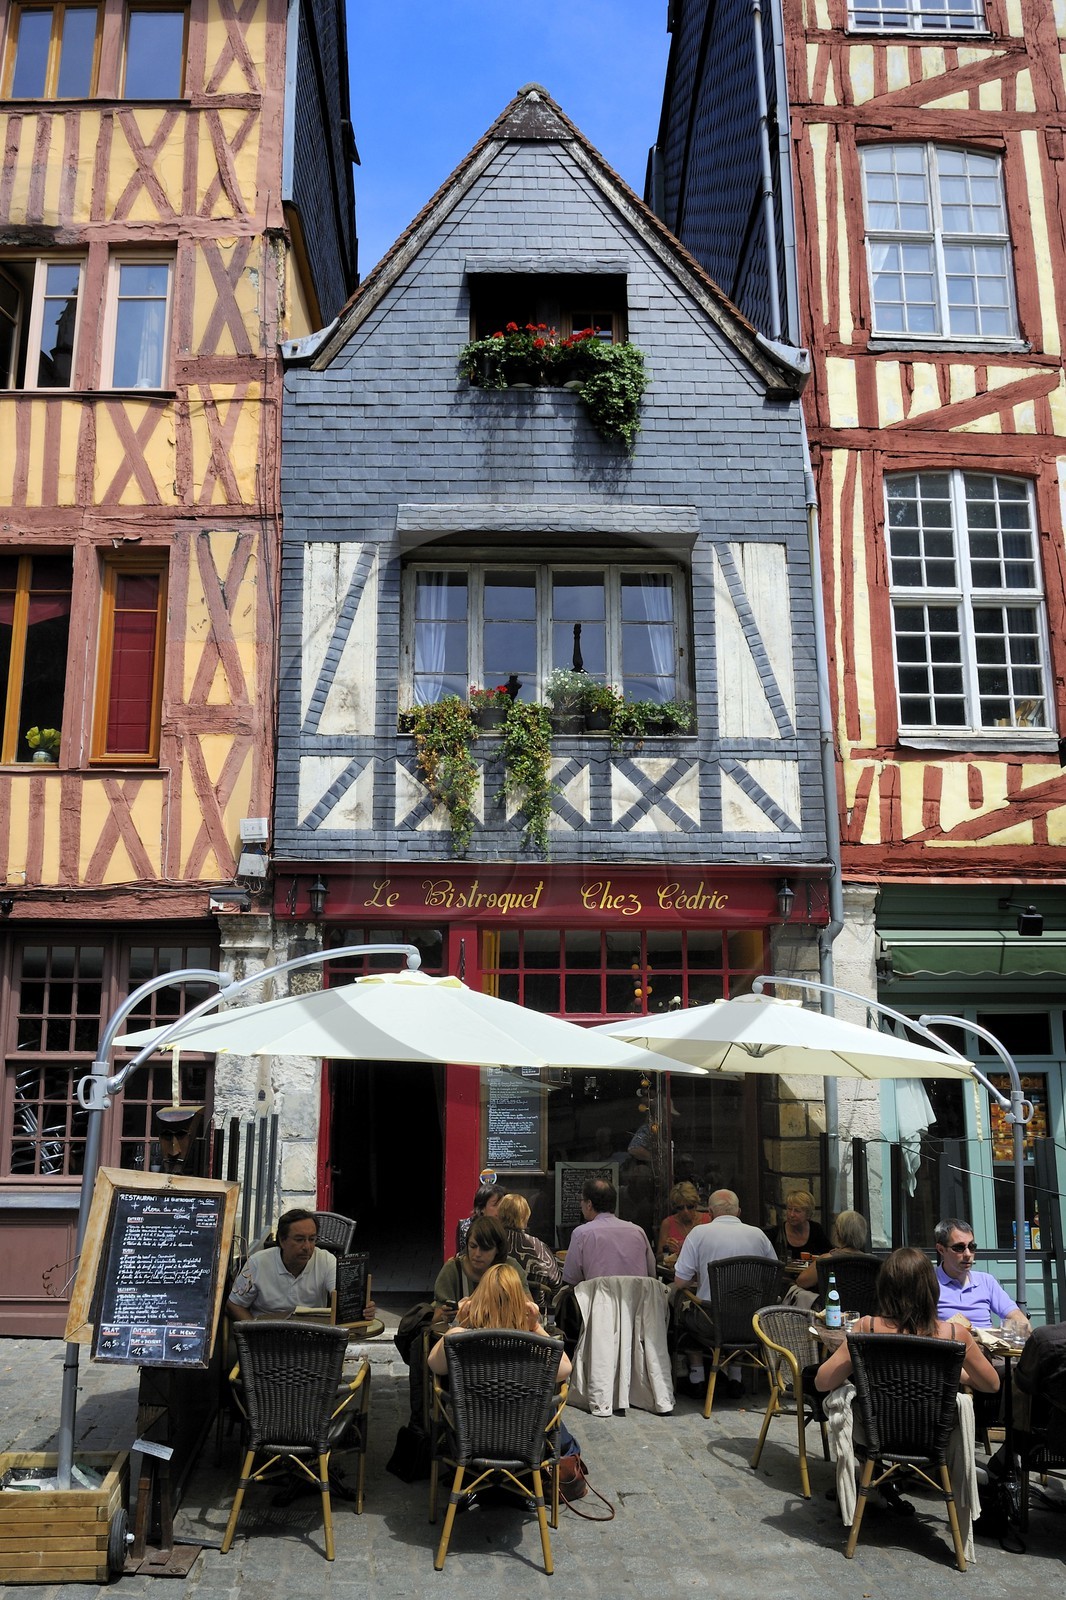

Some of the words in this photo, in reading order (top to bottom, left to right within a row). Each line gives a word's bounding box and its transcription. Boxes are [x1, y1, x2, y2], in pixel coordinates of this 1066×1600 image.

[364, 879, 400, 908] Le
[421, 880, 545, 915] Bistroquet
[580, 881, 642, 916] Chez
[656, 880, 729, 910] Cédric
